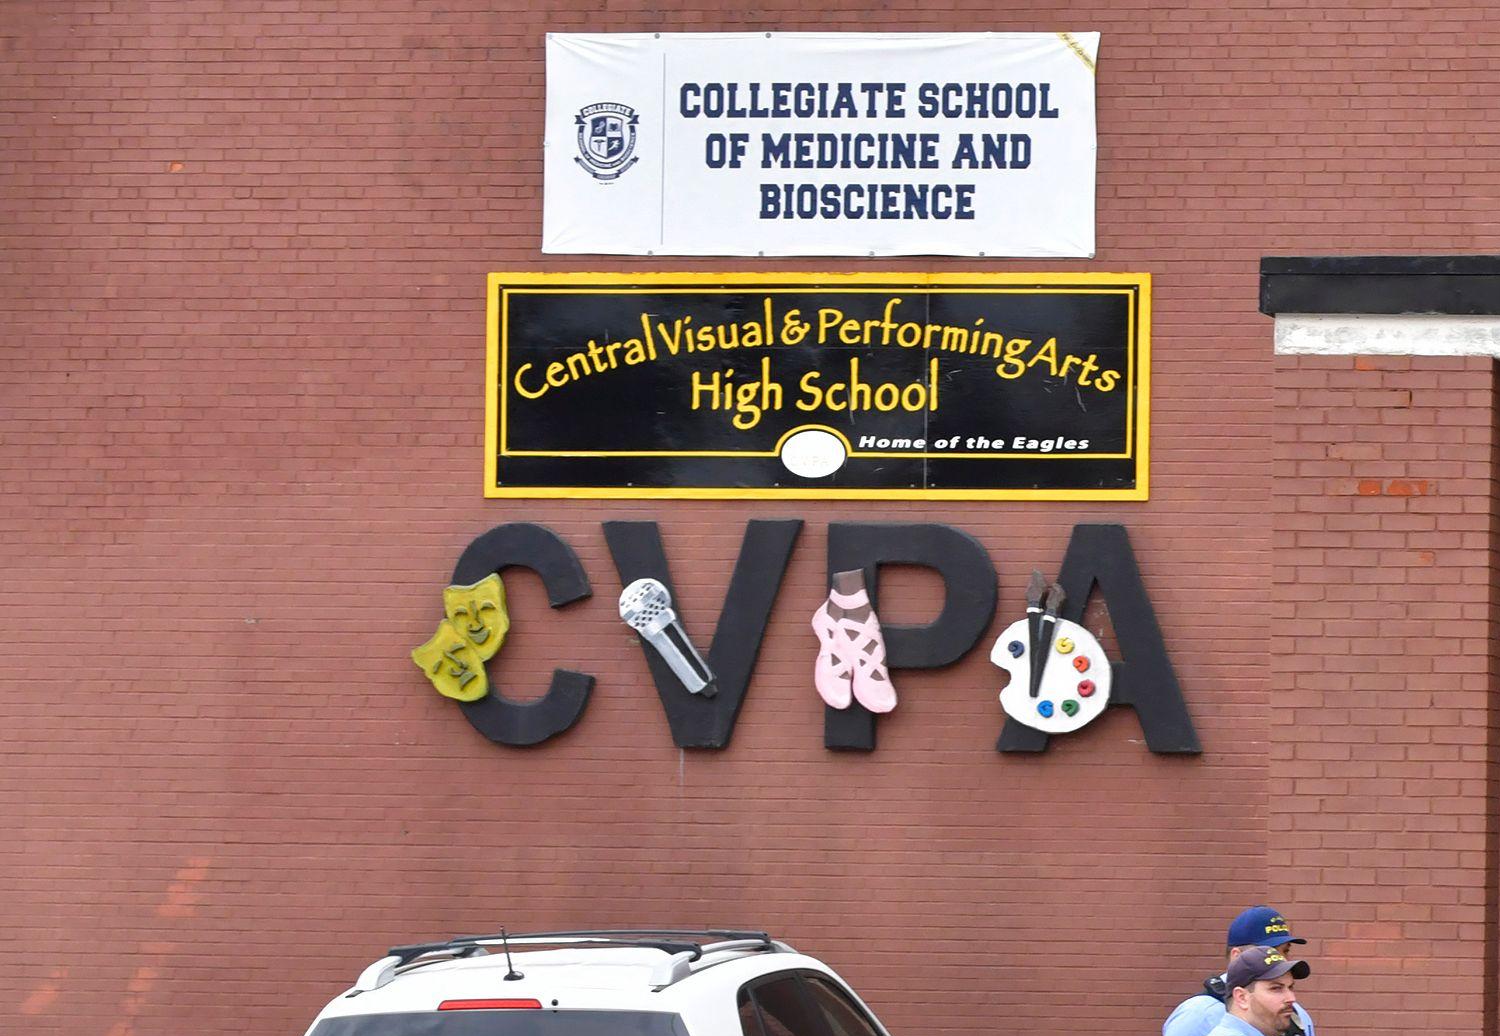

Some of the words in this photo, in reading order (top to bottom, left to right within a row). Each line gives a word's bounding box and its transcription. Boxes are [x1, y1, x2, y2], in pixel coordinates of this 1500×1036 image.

[679, 82, 906, 119] COLLEGIATE
[918, 82, 1059, 119] SCHOOL
[705, 132, 750, 169] OF
[760, 132, 940, 169] MEDICINE
[951, 133, 1032, 170] AND
[759, 183, 976, 220] BIOSCIENCE
[514, 312, 657, 399] Central
[657, 297, 774, 356] Visual
[780, 308, 811, 346] &
[817, 297, 1032, 380] Performing
[1026, 337, 1121, 392] Arts
[691, 356, 783, 430] High
[795, 356, 939, 412] School
[858, 435, 927, 449] Home
[934, 435, 961, 449] of
[966, 437, 1005, 449] the
[1012, 436, 1090, 453] Eagles
[449, 520, 1209, 766] CVPA
